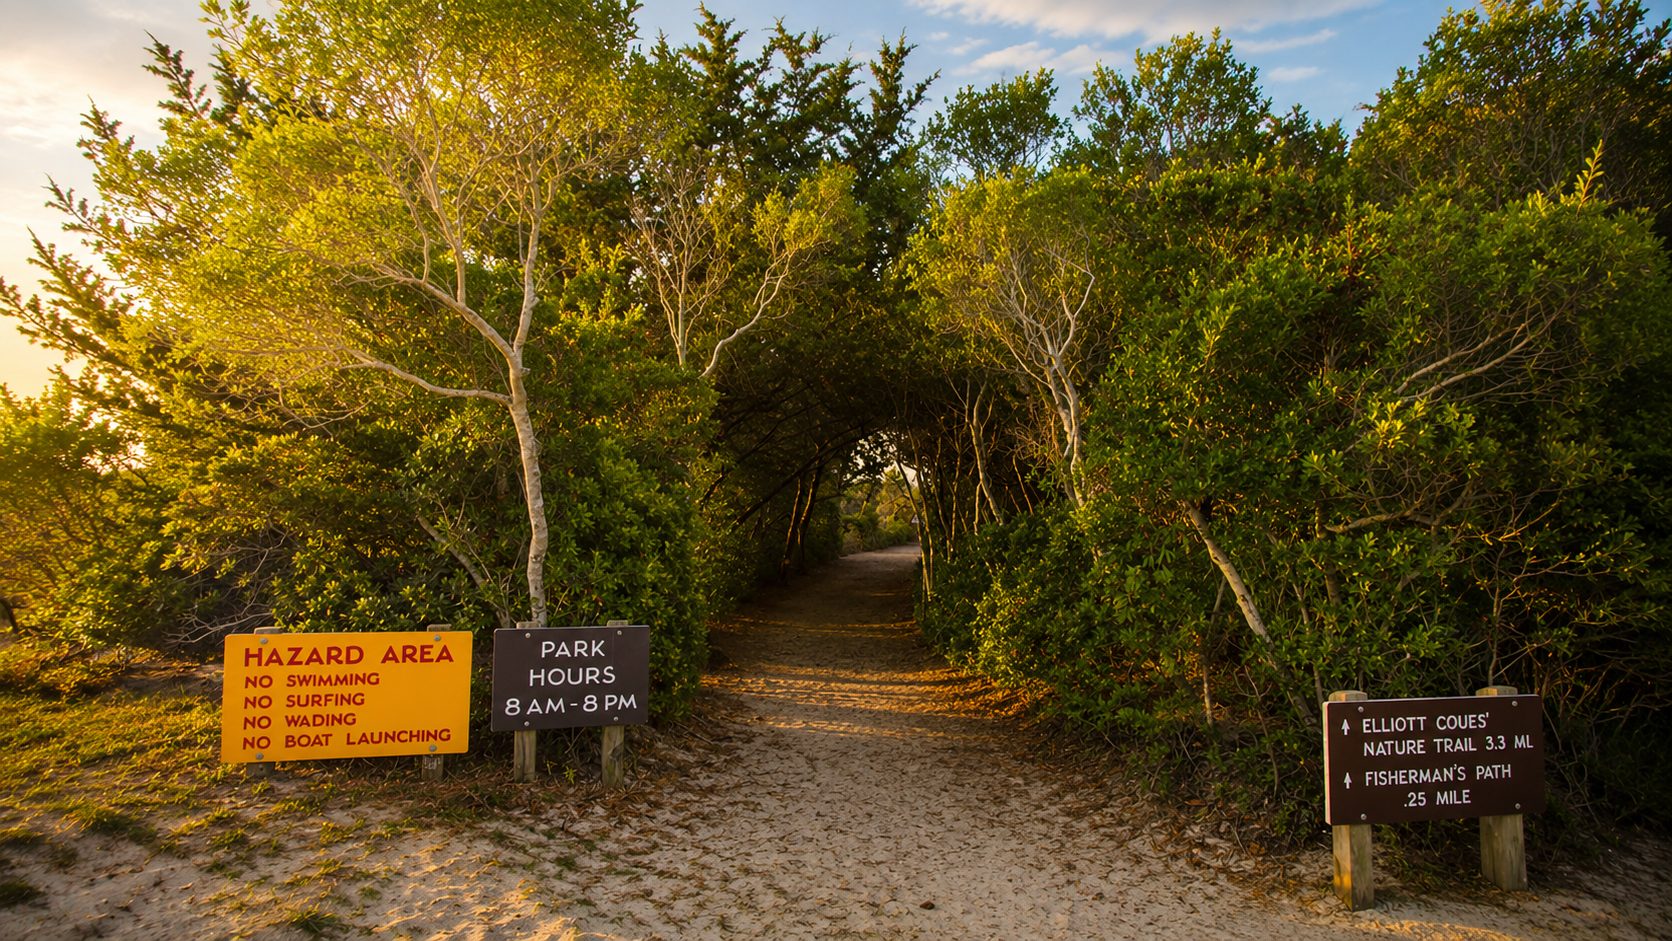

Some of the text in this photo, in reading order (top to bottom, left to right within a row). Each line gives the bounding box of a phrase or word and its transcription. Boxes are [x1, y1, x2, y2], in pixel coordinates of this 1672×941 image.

[244, 644, 455, 668] HAZARD AREA
[541, 639, 605, 658] PARK
[244, 671, 381, 689] NO SWIMMING
[529, 665, 616, 687] HOURS
[244, 692, 366, 710] NO SURFING
[504, 698, 521, 716] 8
[526, 697, 565, 715] AM
[582, 694, 598, 712] 8
[604, 693, 637, 711] PM
[243, 712, 357, 731] NO WADING
[1362, 711, 1489, 734] ELLIOTT COUES'
[242, 727, 452, 751] NO BOAT LAUNCHING
[1363, 734, 1534, 757] NATURE TRAIL 3.3 ML
[1365, 763, 1512, 787] FISHERMAN'S PATH
[1403, 789, 1471, 808] .25 MILE
